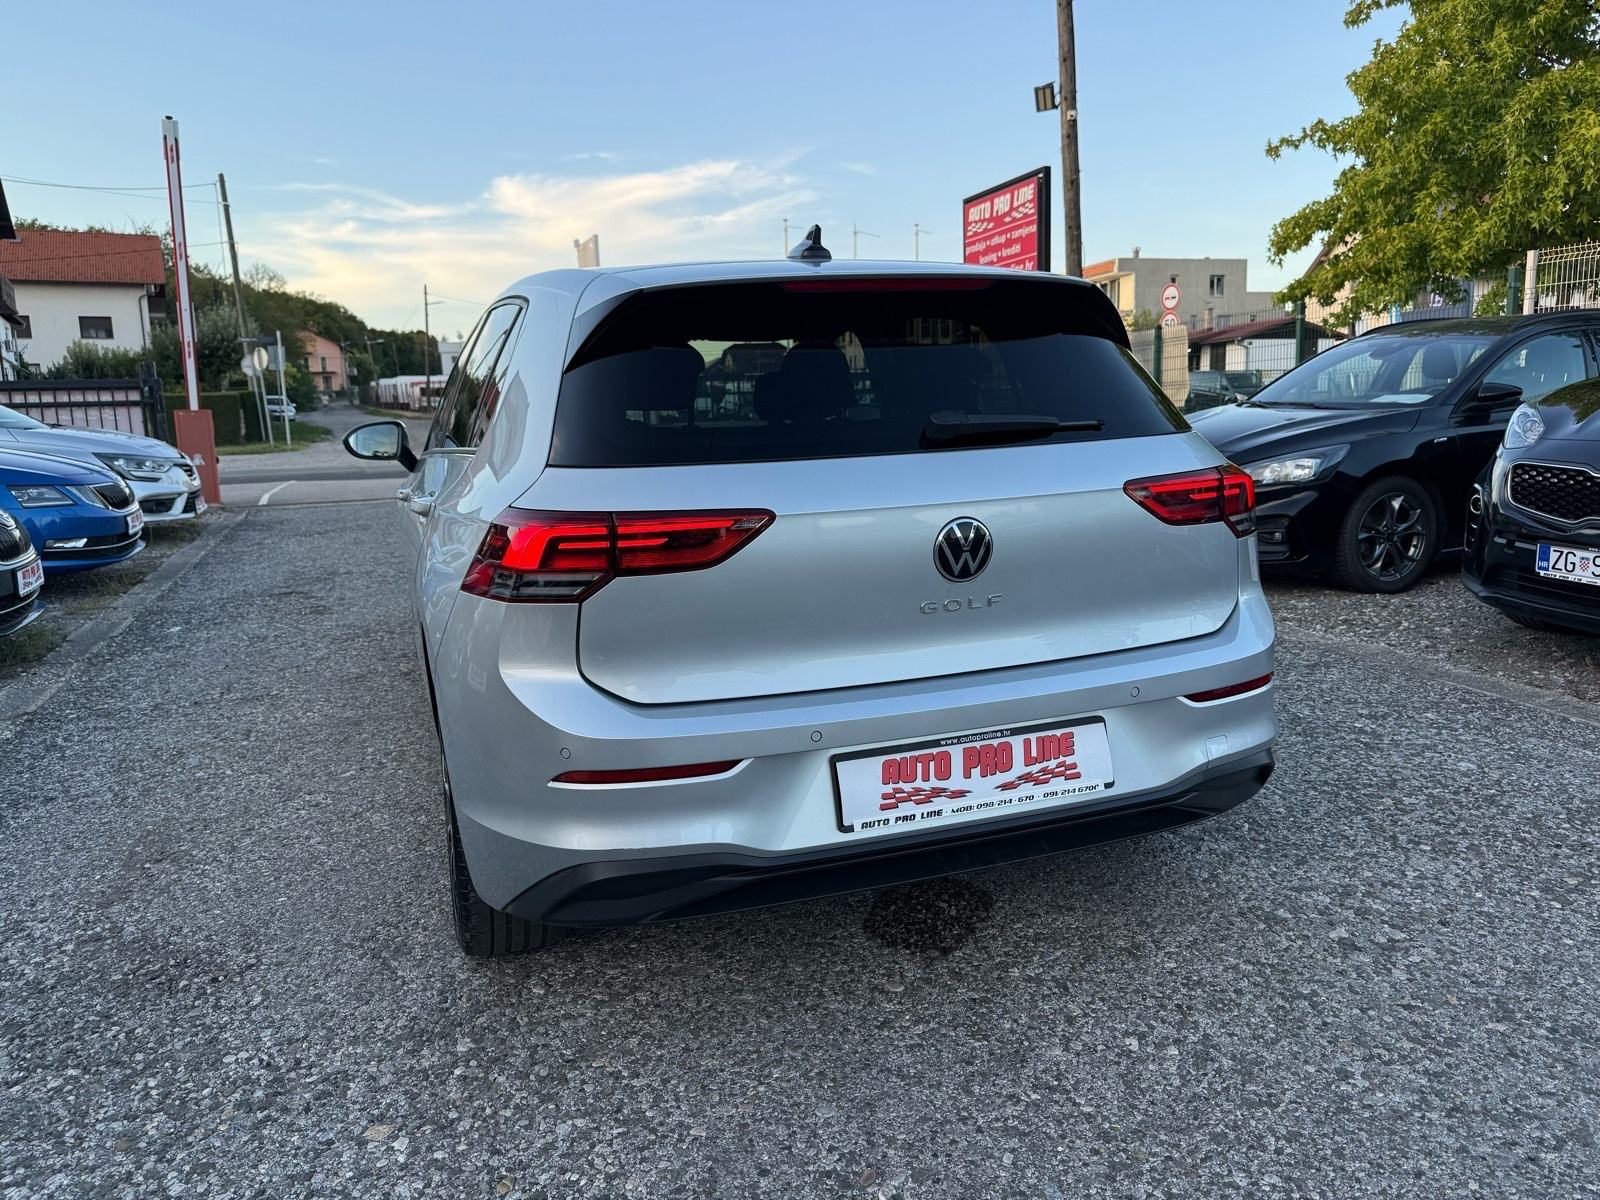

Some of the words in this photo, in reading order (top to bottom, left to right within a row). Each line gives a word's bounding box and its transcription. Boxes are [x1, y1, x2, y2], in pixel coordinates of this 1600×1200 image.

[968, 201, 991, 222] AUTO
[993, 193, 1011, 217] PRO
[1013, 183, 1035, 208] LINE
[965, 240, 986, 256] prodaja
[990, 234, 1006, 246] otkup
[1011, 224, 1036, 239] zamjena
[979, 251, 997, 264] leasing
[1001, 243, 1021, 257] krediti
[1552, 550, 1576, 573] ZG
[920, 593, 1002, 615] GOLF
[940, 730, 1011, 745] www.autoproline.hr
[882, 750, 952, 785] AUTO
[962, 741, 1013, 779] PRO
[1023, 731, 1075, 767] LINE
[860, 818, 890, 830] AUTO
[895, 813, 916, 824] PRO
[920, 809, 943, 820] LINE
[951, 805, 975, 814] MOB:
[1043, 788, 1077, 799] 091/214
